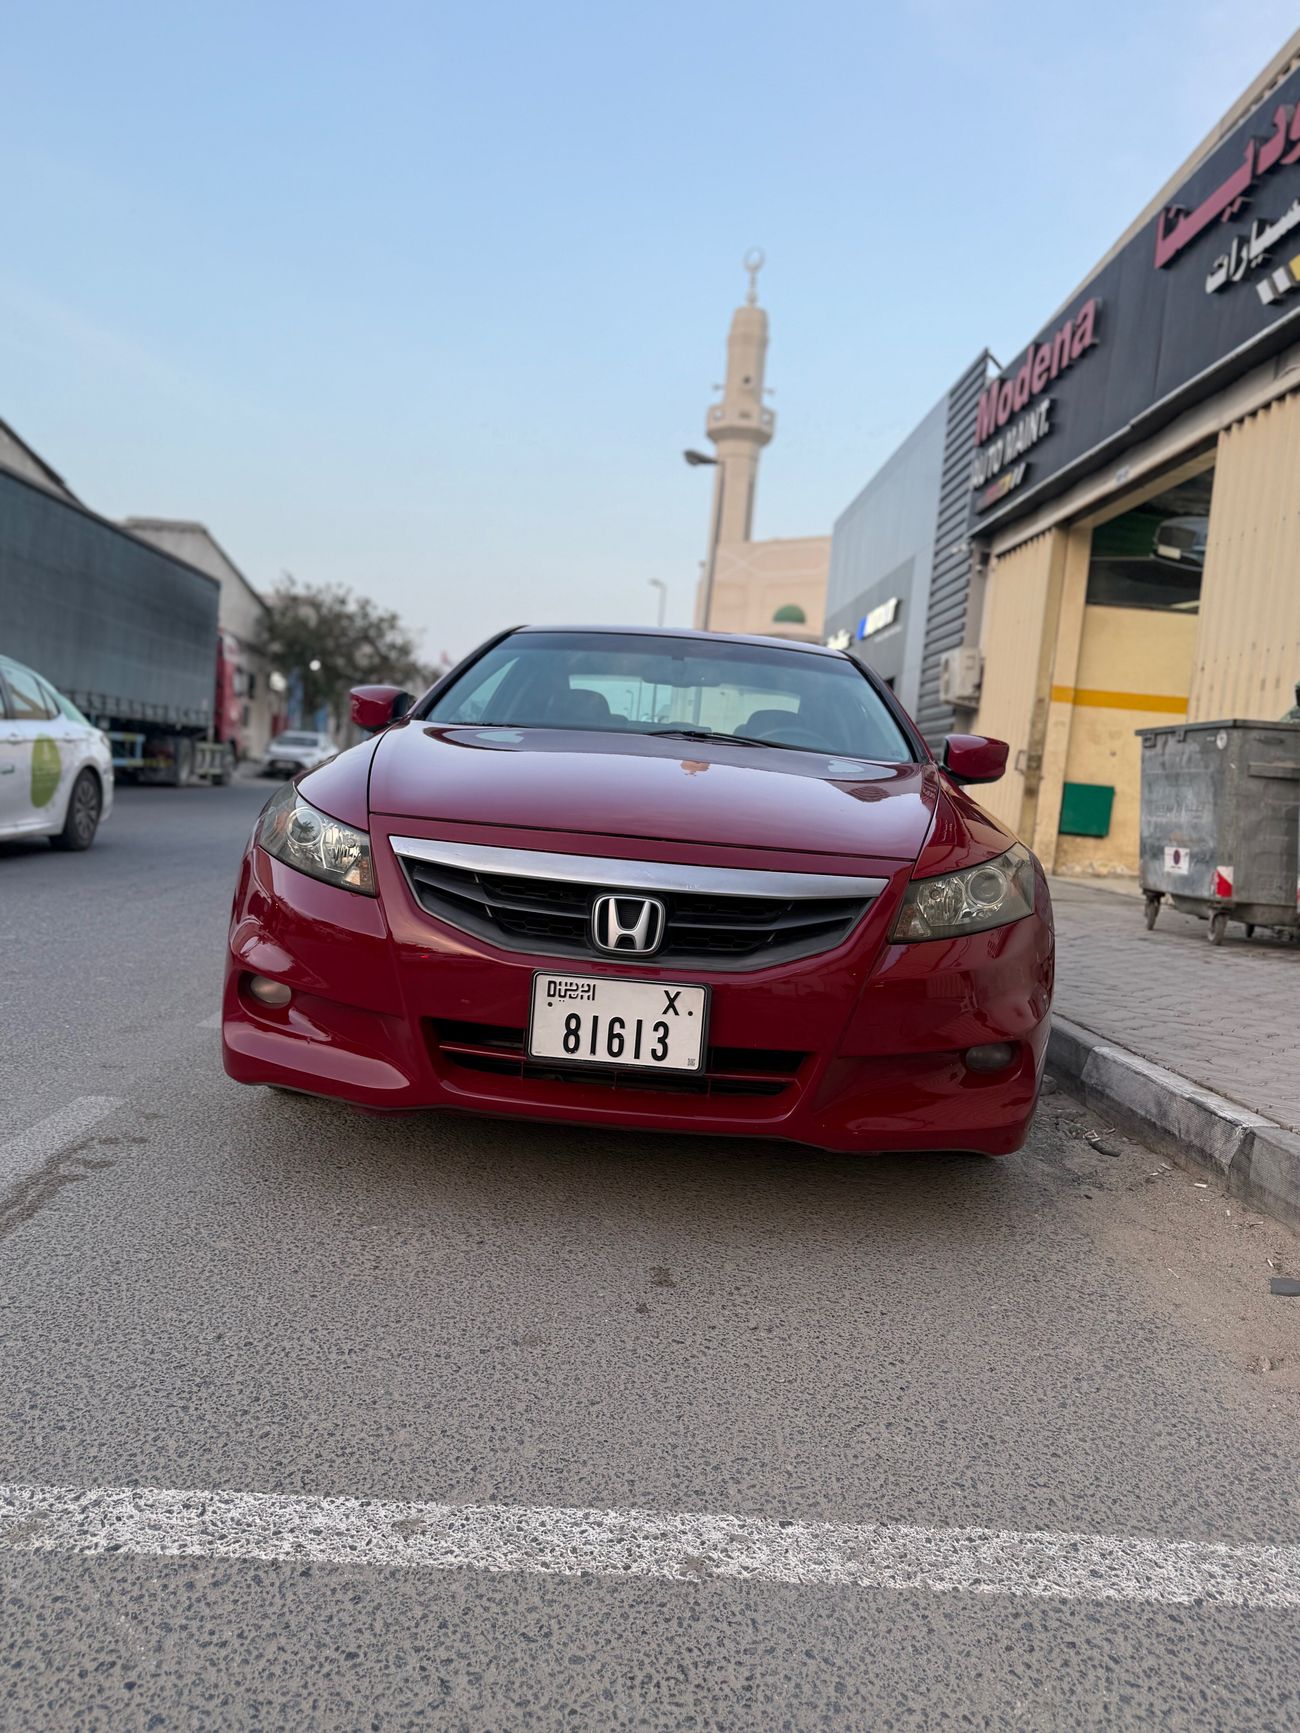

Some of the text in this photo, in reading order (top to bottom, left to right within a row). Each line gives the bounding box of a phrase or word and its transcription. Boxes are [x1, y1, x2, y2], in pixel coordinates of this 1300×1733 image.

[974, 297, 1097, 448] Modena
[662, 990, 682, 1016] X
[562, 1012, 670, 1062] 81613
